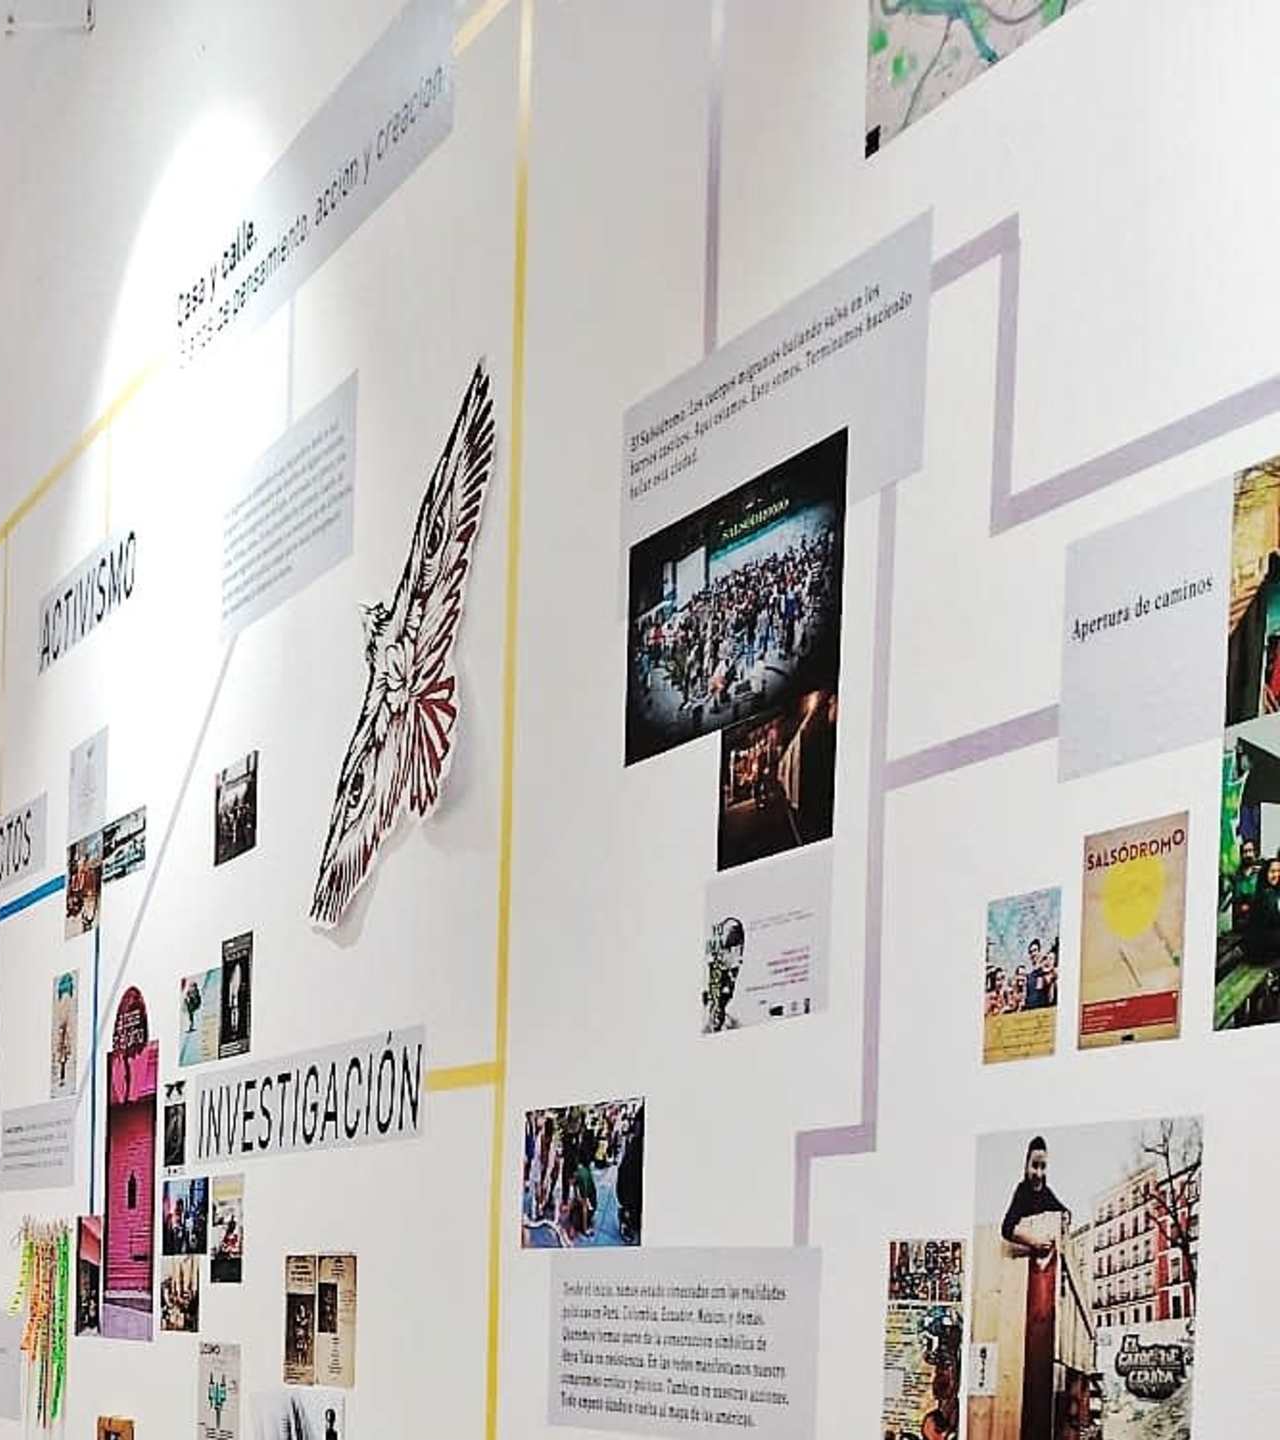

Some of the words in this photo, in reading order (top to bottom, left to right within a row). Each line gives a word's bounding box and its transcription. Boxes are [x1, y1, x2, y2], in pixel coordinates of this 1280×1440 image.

[38, 531, 136, 677] ACTIVISMO
[1072, 606, 1130, 642] Apertura
[1135, 594, 1150, 618] de
[1154, 576, 1214, 610] caminos
[1087, 828, 1186, 871] SALSÓDROMO
[198, 1031, 423, 1159] INVESTIGACIÓN
